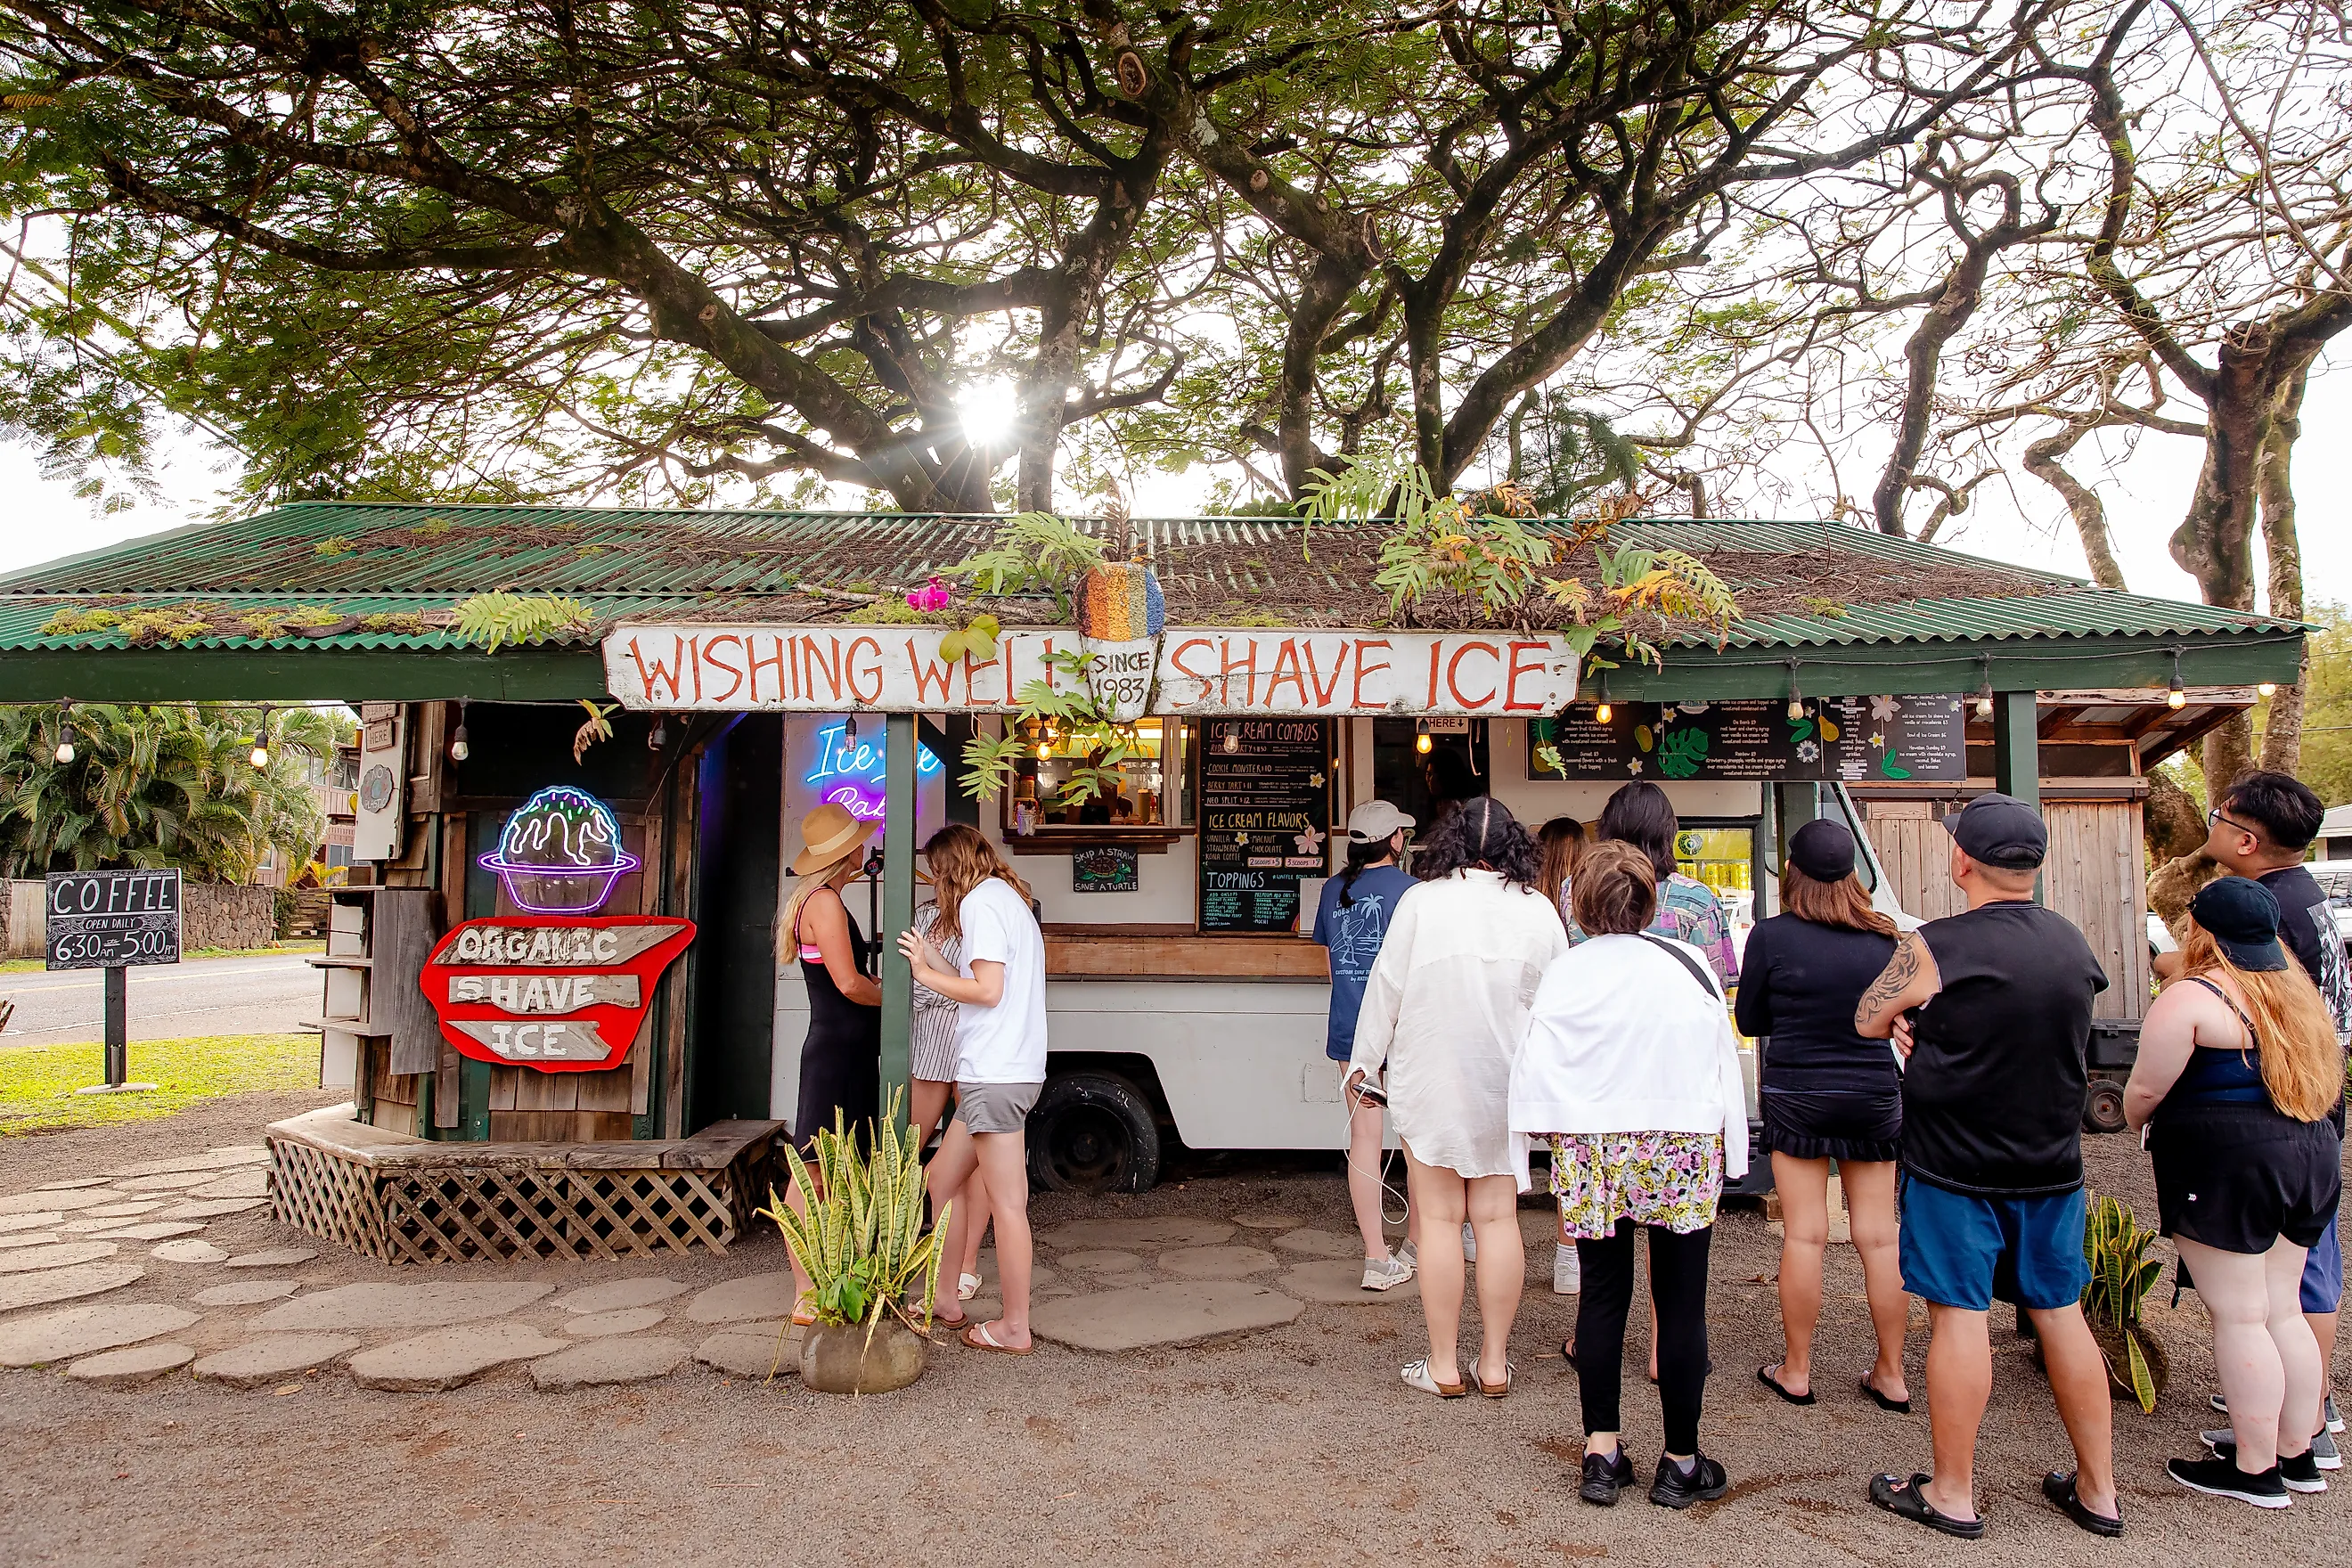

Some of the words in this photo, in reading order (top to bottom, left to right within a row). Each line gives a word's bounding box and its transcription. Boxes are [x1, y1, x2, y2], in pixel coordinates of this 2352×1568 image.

[628, 633, 883, 705] WISHING
[1091, 651, 1150, 674] SINCE
[1171, 637, 1393, 709] SHAVE
[1425, 638, 1553, 712] ICE
[1096, 678, 1145, 704] 1983
[1211, 723, 1230, 739] ICE
[1237, 722, 1272, 739] CREAM
[1277, 723, 1319, 741] COMBOS
[1429, 718, 1456, 728] HERE
[370, 730, 388, 745] HERE
[806, 725, 877, 784] Ice
[1237, 744, 1253, 753] IRTY
[1208, 764, 1229, 773] COOKIE
[1231, 764, 1262, 773] MONSTER
[1207, 781, 1226, 790] BERRY
[1228, 781, 1242, 790] TART
[1206, 796, 1219, 804] NEO
[1221, 796, 1237, 804] SPLIT
[1208, 813, 1225, 829] ICE
[1228, 812, 1262, 829] CREAM
[1267, 812, 1310, 829] FLAVORS
[1206, 834, 1230, 843] VANILLA
[1074, 850, 1095, 863] SKIP
[1107, 848, 1137, 861] STRAW
[1205, 853, 1221, 861] KONA
[1222, 853, 1240, 861] COFFEE
[1206, 844, 1240, 853] STRAWBERRY
[1251, 845, 1282, 853] CHOCOLATE
[1074, 882, 1095, 891] SAVE
[1107, 882, 1138, 891] TURTLE
[1206, 871, 1264, 889] TOPPINGS
[53, 876, 177, 914] COFFEE
[1332, 908, 1350, 919] DOES
[1351, 902, 1359, 912] IT
[85, 919, 109, 930] OPEN
[111, 918, 135, 928] DAILY
[55, 934, 102, 961] 6:30
[100, 947, 114, 957] AM
[120, 929, 167, 959] 5:00
[164, 944, 176, 955] PM
[458, 928, 618, 961] ORGANIC
[457, 976, 595, 1009] SHAVE
[491, 1025, 568, 1056] ICE
